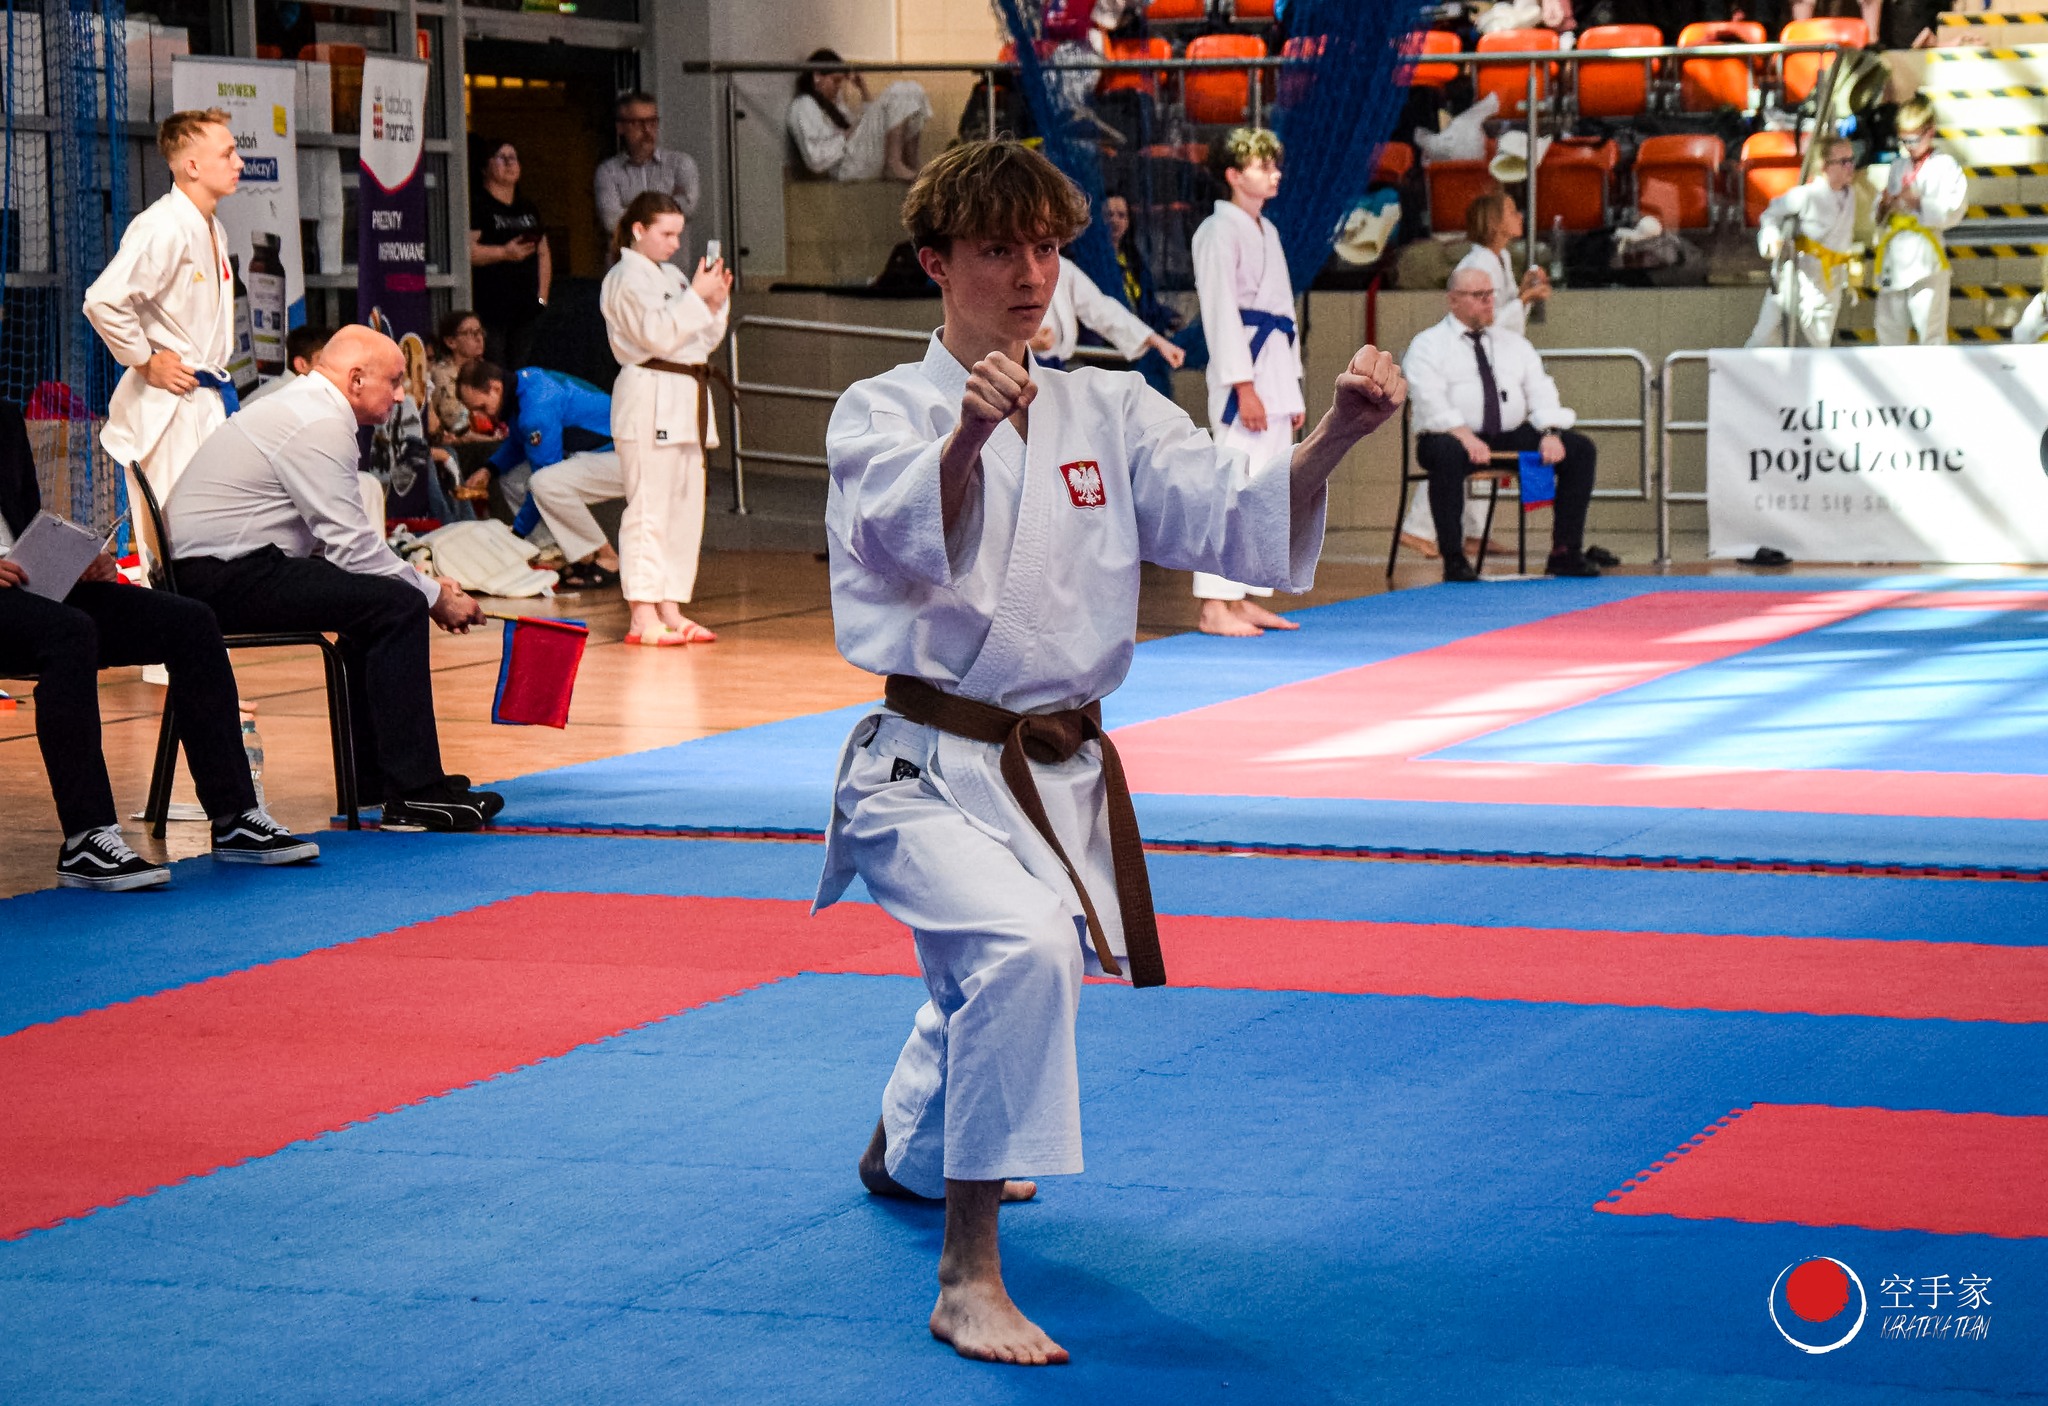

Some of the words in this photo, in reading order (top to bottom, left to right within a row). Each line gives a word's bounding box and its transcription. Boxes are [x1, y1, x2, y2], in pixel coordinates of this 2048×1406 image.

[1779, 400, 1932, 432] zdrowo
[1750, 437, 1965, 481] pojedzone
[1754, 493, 1809, 511] ciesz
